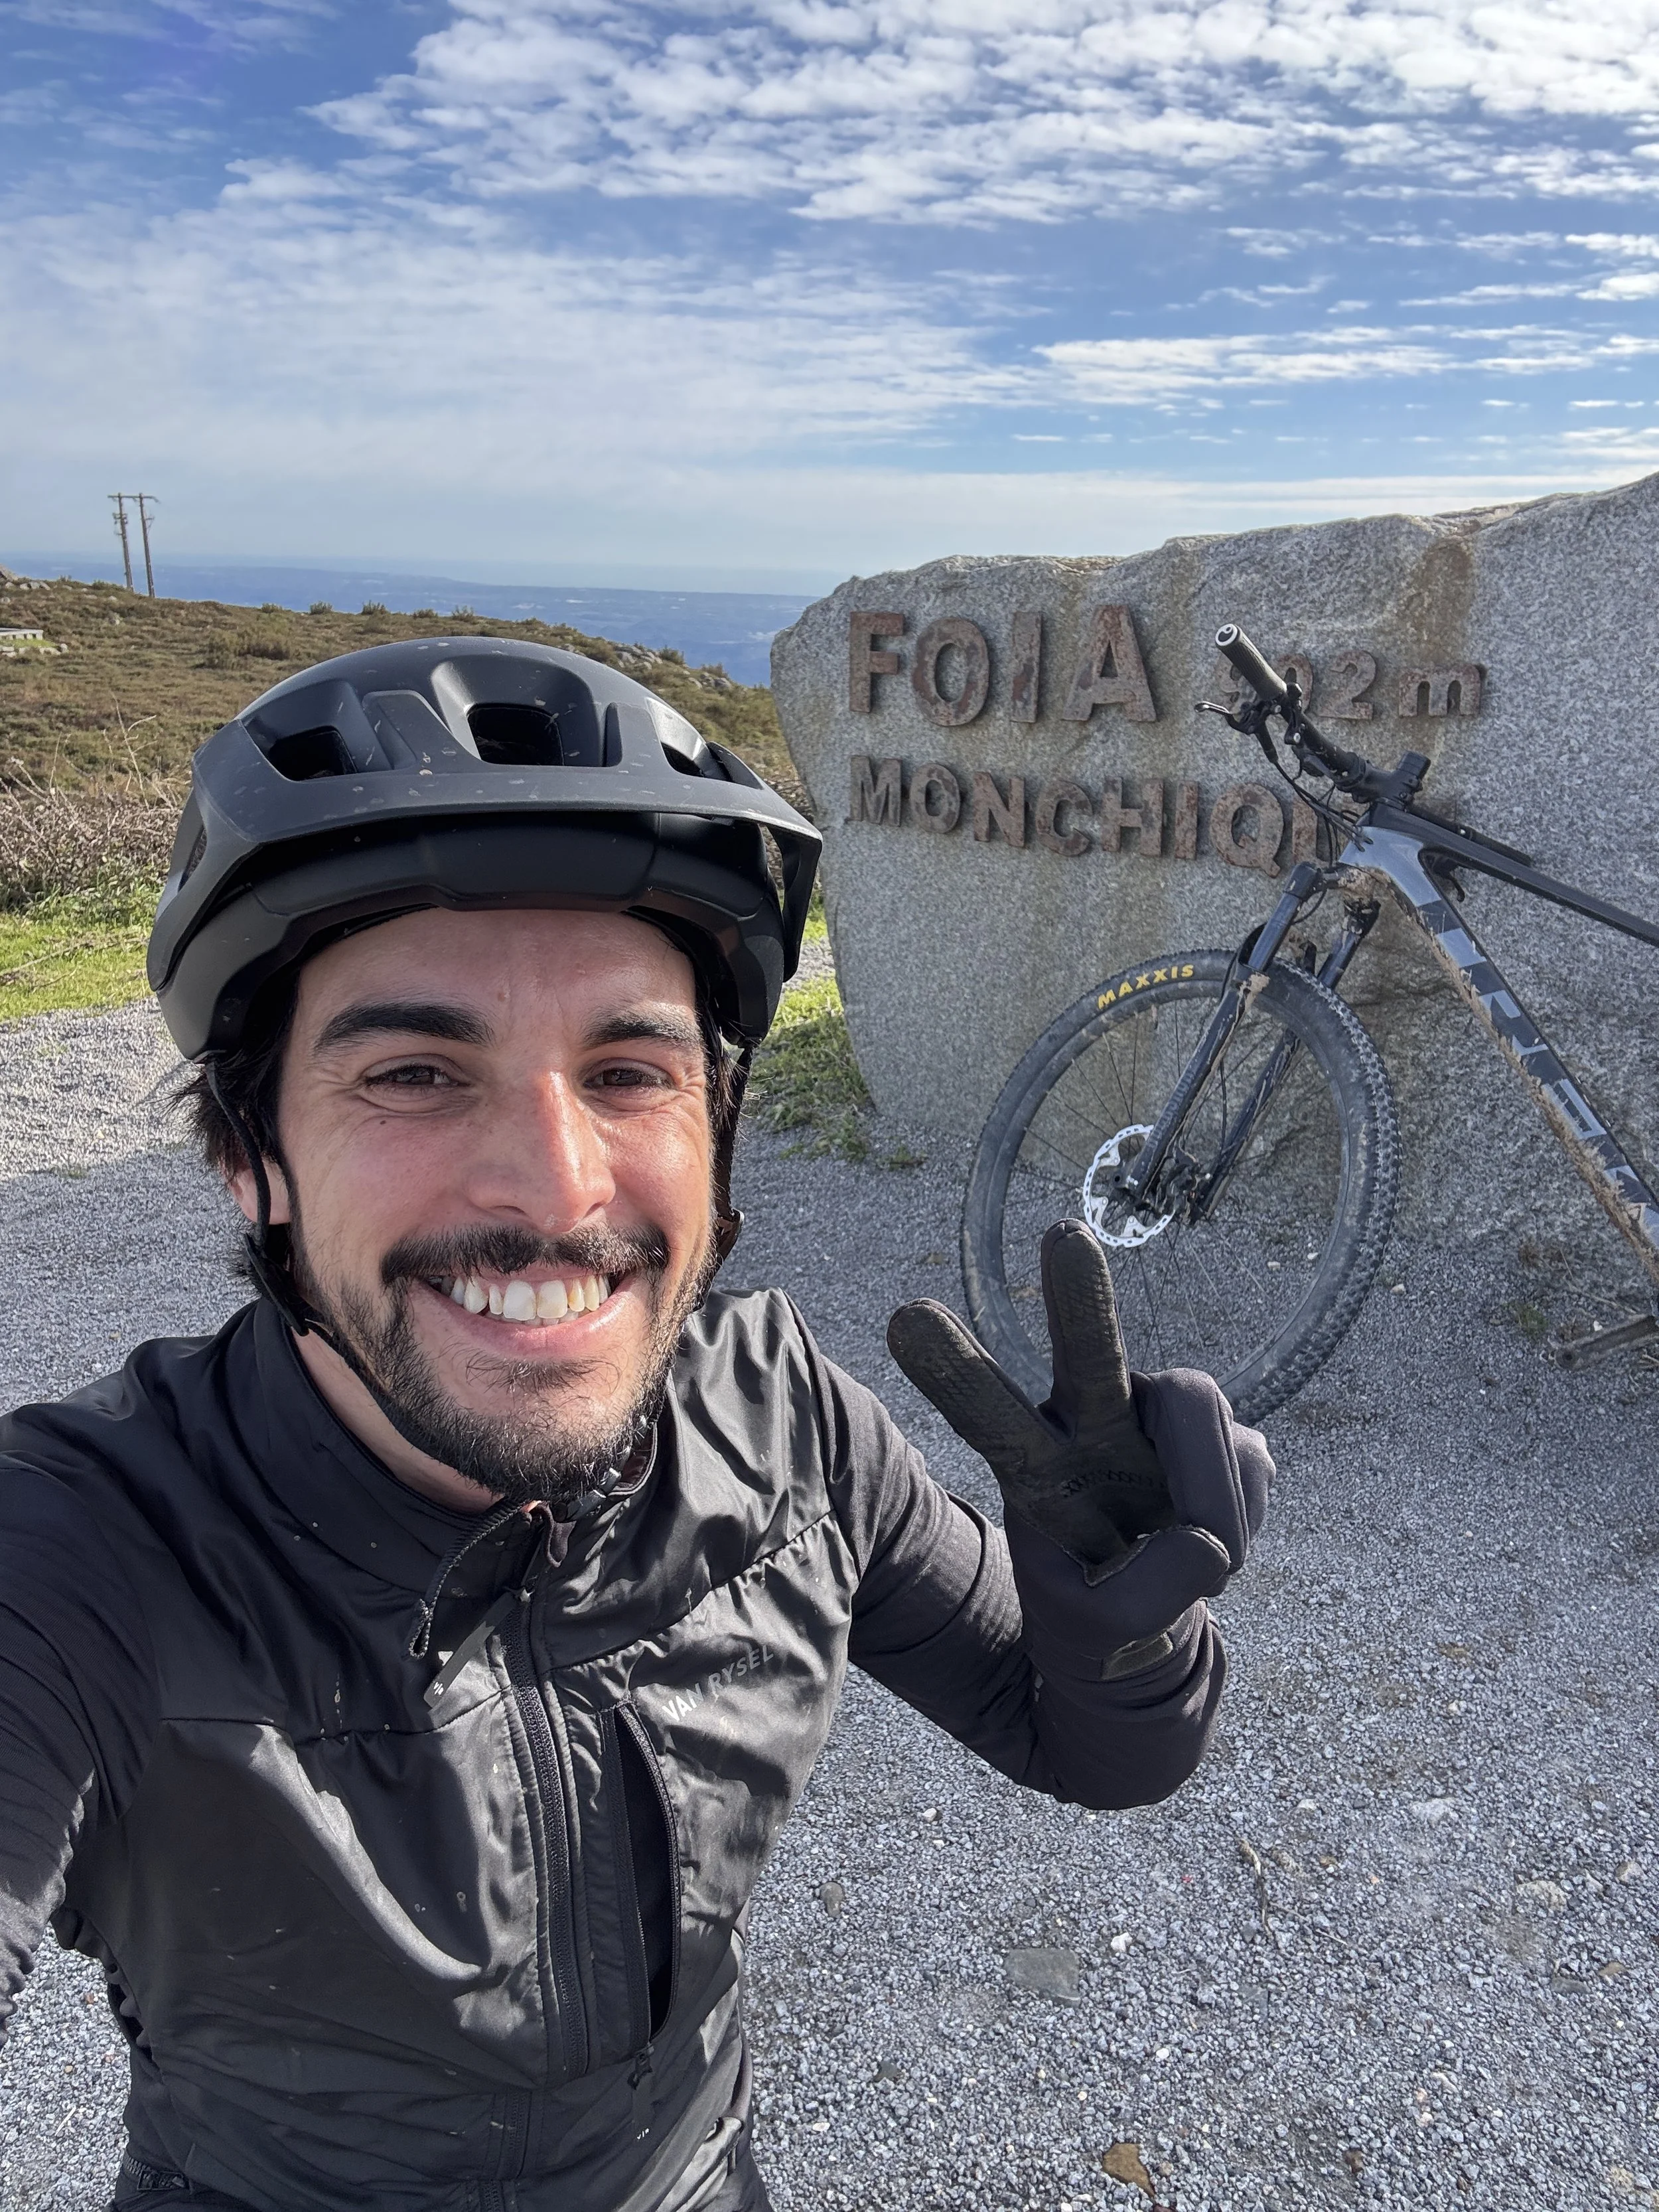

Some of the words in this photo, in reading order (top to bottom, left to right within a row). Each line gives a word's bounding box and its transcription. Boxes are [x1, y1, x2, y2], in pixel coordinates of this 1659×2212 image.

[849, 605, 1157, 727] FOIA
[1398, 664, 1484, 718] m
[1098, 964, 1194, 1009] MAXXIS
[663, 1683, 705, 1722] VAN
[708, 1645, 774, 1696] RYSEL
